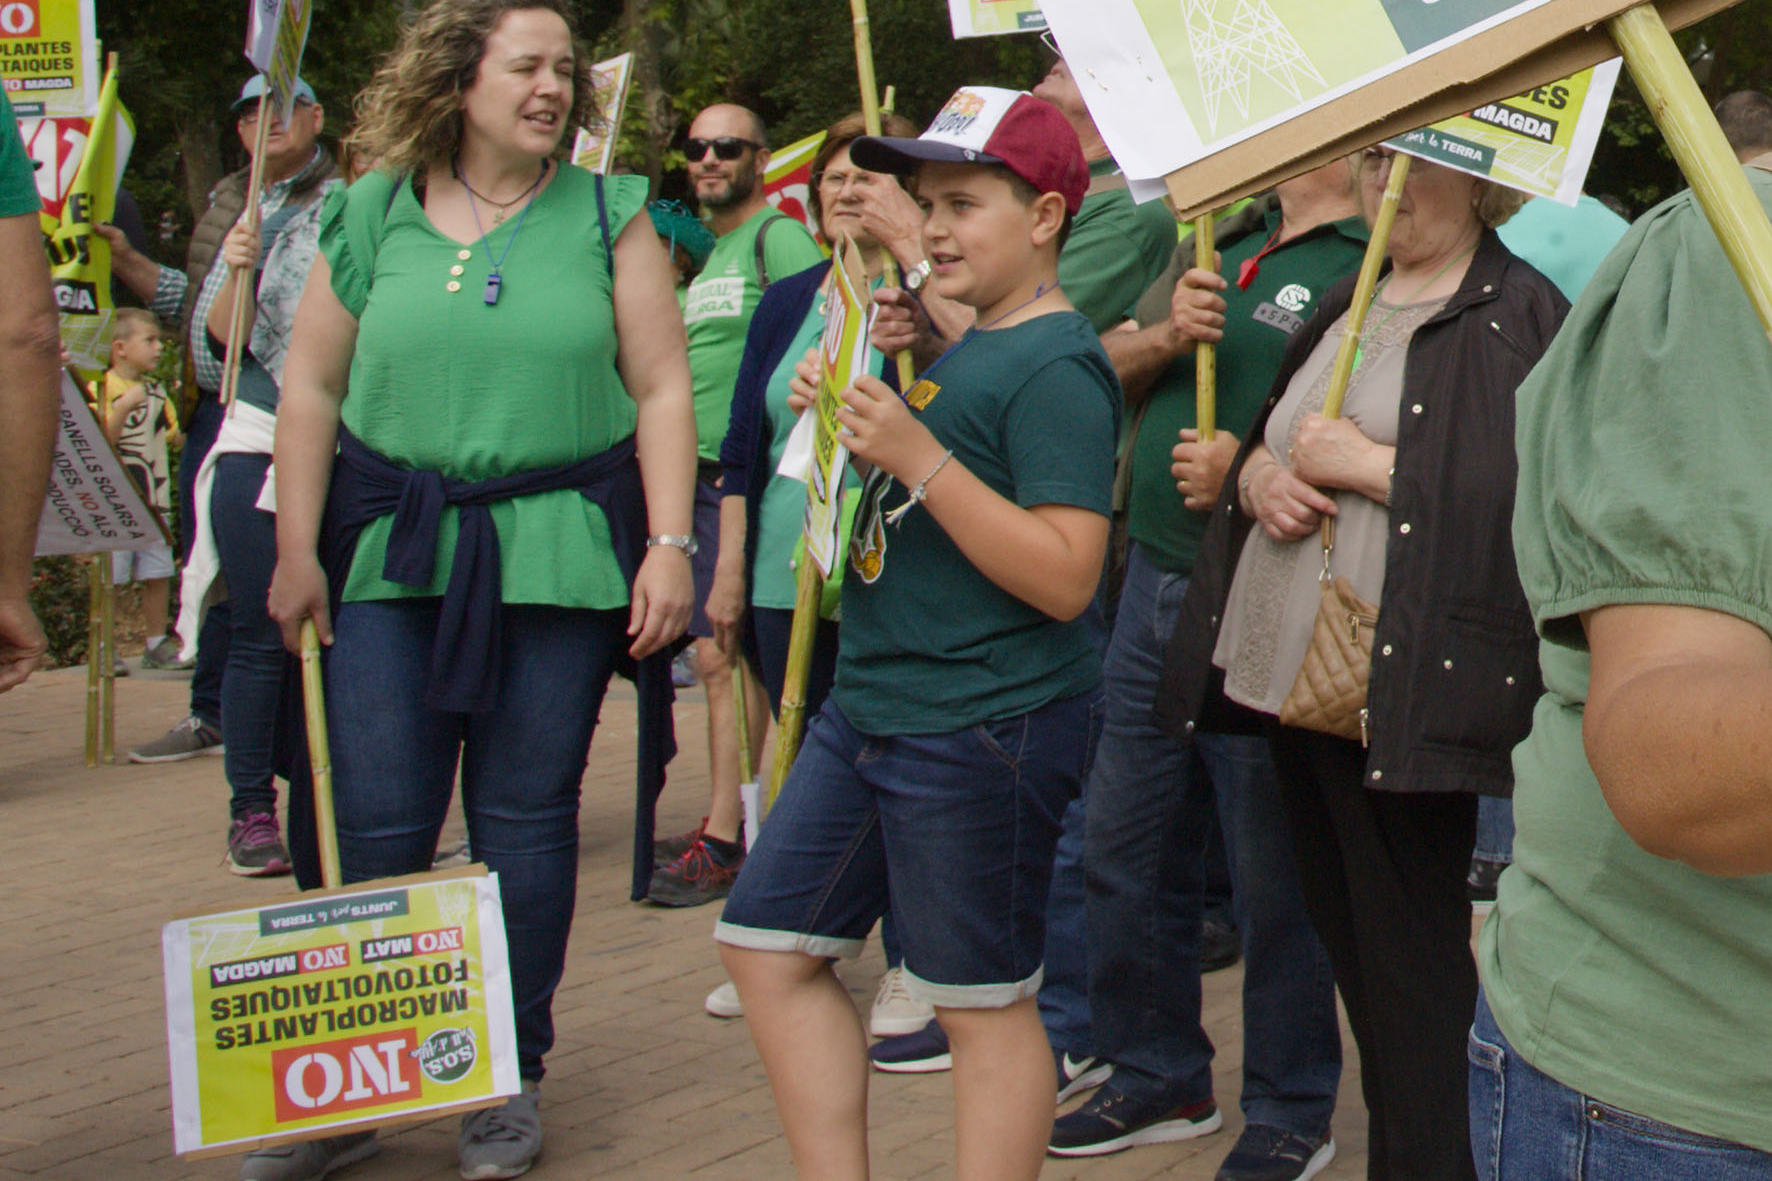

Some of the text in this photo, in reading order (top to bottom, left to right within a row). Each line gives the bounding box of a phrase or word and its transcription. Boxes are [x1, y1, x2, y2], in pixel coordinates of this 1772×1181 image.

[0, 2, 34, 33] O
[0, 58, 74, 73] TAIQUES
[24, 77, 72, 90] MAGDA
[1473, 105, 1552, 140] MAGDA
[1441, 140, 1483, 162] TERRA
[60, 409, 146, 540] PANELLS SOLARS A
[76, 492, 100, 512] NO
[89, 513, 117, 538] ALS
[272, 914, 315, 929] TERRA
[351, 900, 398, 916] JUNTS
[214, 930, 460, 982] NO MAT NO MAGDA
[211, 959, 468, 1021] FOTOVOLTAIQUES
[215, 988, 468, 1050] MACROPLANTES
[285, 1038, 410, 1108] NO
